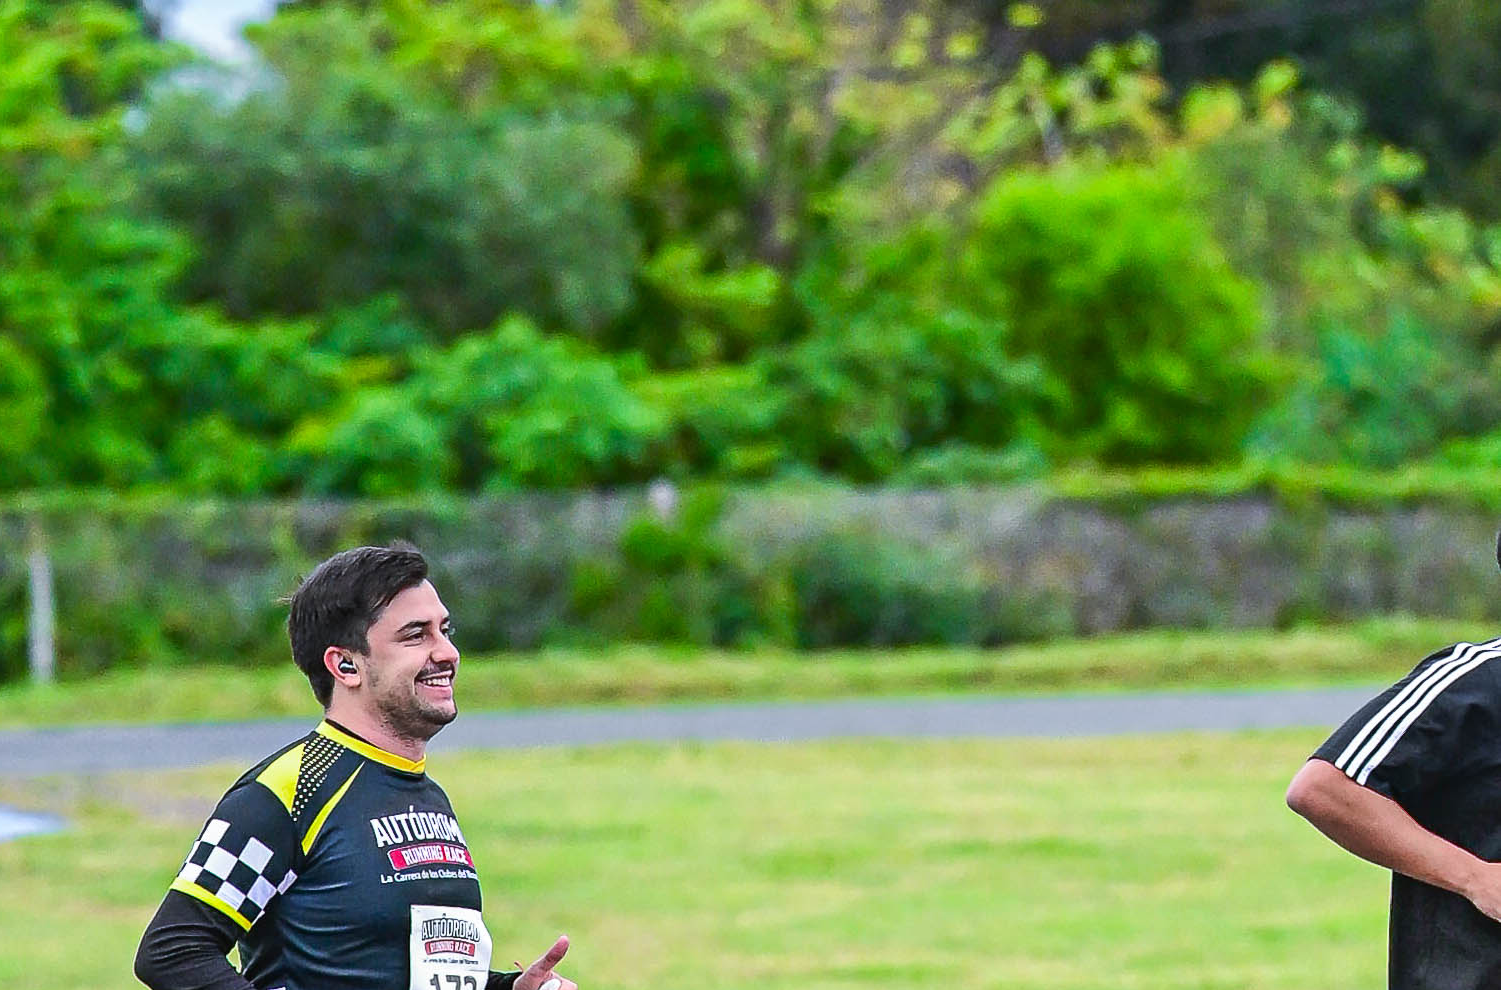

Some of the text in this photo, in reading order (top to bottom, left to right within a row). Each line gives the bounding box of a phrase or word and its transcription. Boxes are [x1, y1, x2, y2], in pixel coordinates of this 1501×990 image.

[370, 805, 466, 848] AUTÓDROM
[401, 846, 469, 866] RUNNING RACE
[380, 874, 394, 884] La
